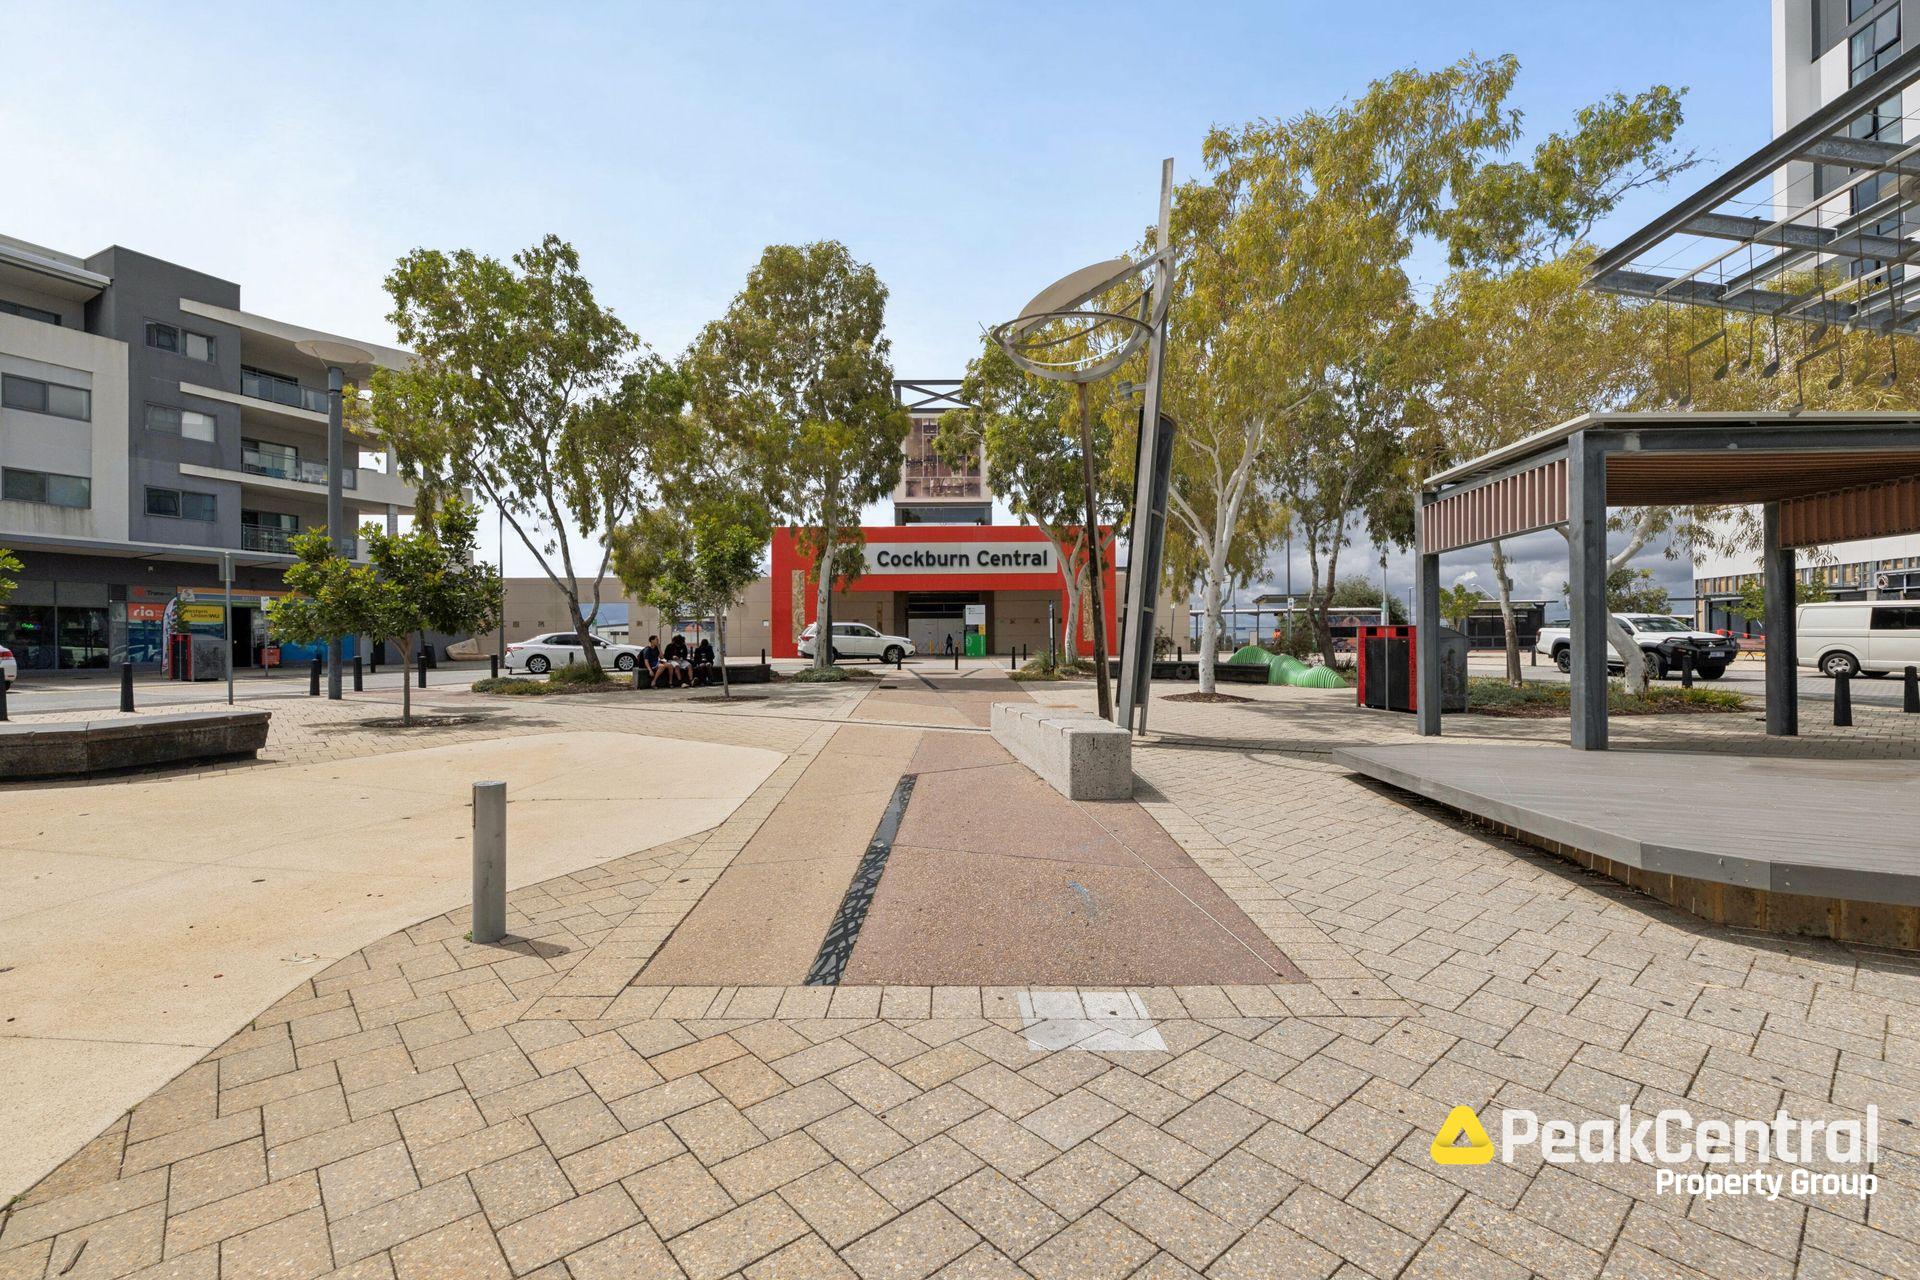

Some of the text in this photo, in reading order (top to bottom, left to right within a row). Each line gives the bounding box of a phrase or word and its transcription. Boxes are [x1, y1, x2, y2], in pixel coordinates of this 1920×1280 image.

[877, 550, 1048, 567] Cockburn Central
[133, 606, 154, 617] ria
